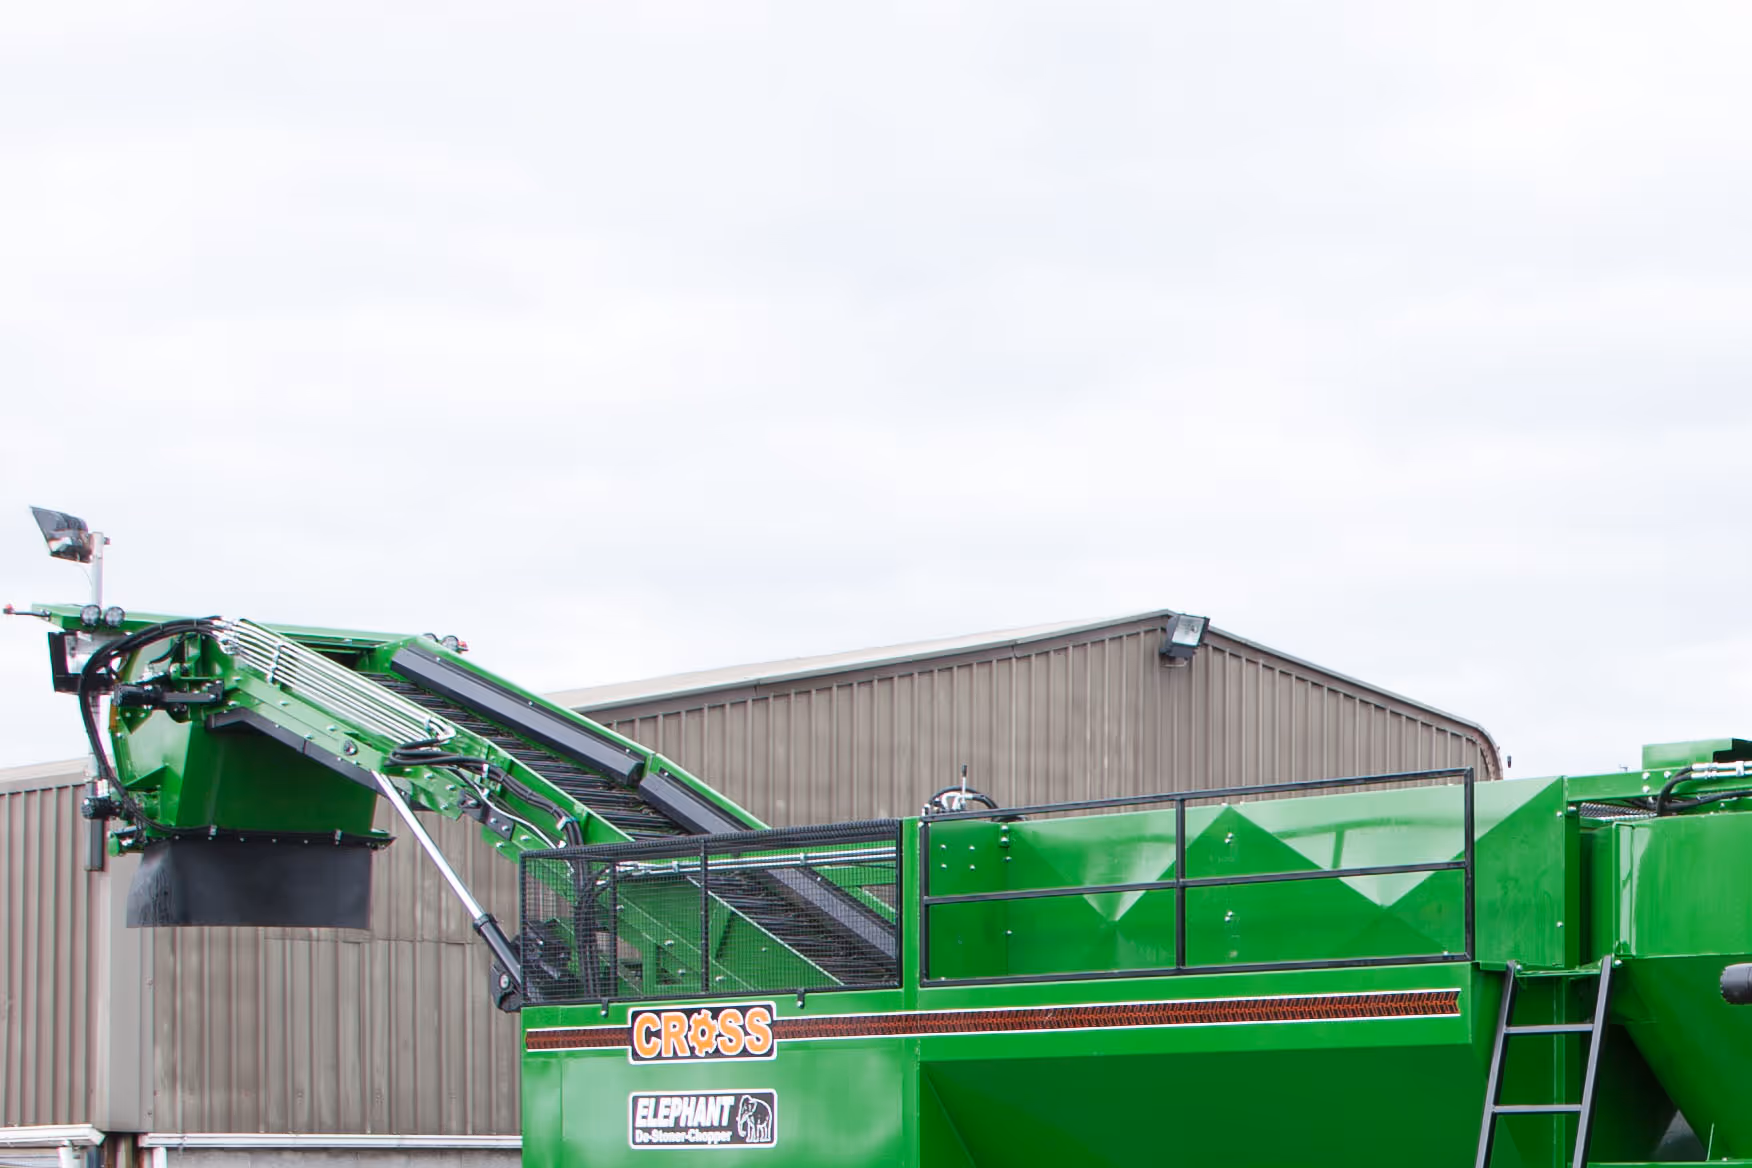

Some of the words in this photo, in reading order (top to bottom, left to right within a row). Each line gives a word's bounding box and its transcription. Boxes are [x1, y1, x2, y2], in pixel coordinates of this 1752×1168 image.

[633, 1007, 773, 1058] CROSS
[635, 1096, 735, 1127] ELEPHANT
[635, 1128, 732, 1144] De-Stoner-Chopper
